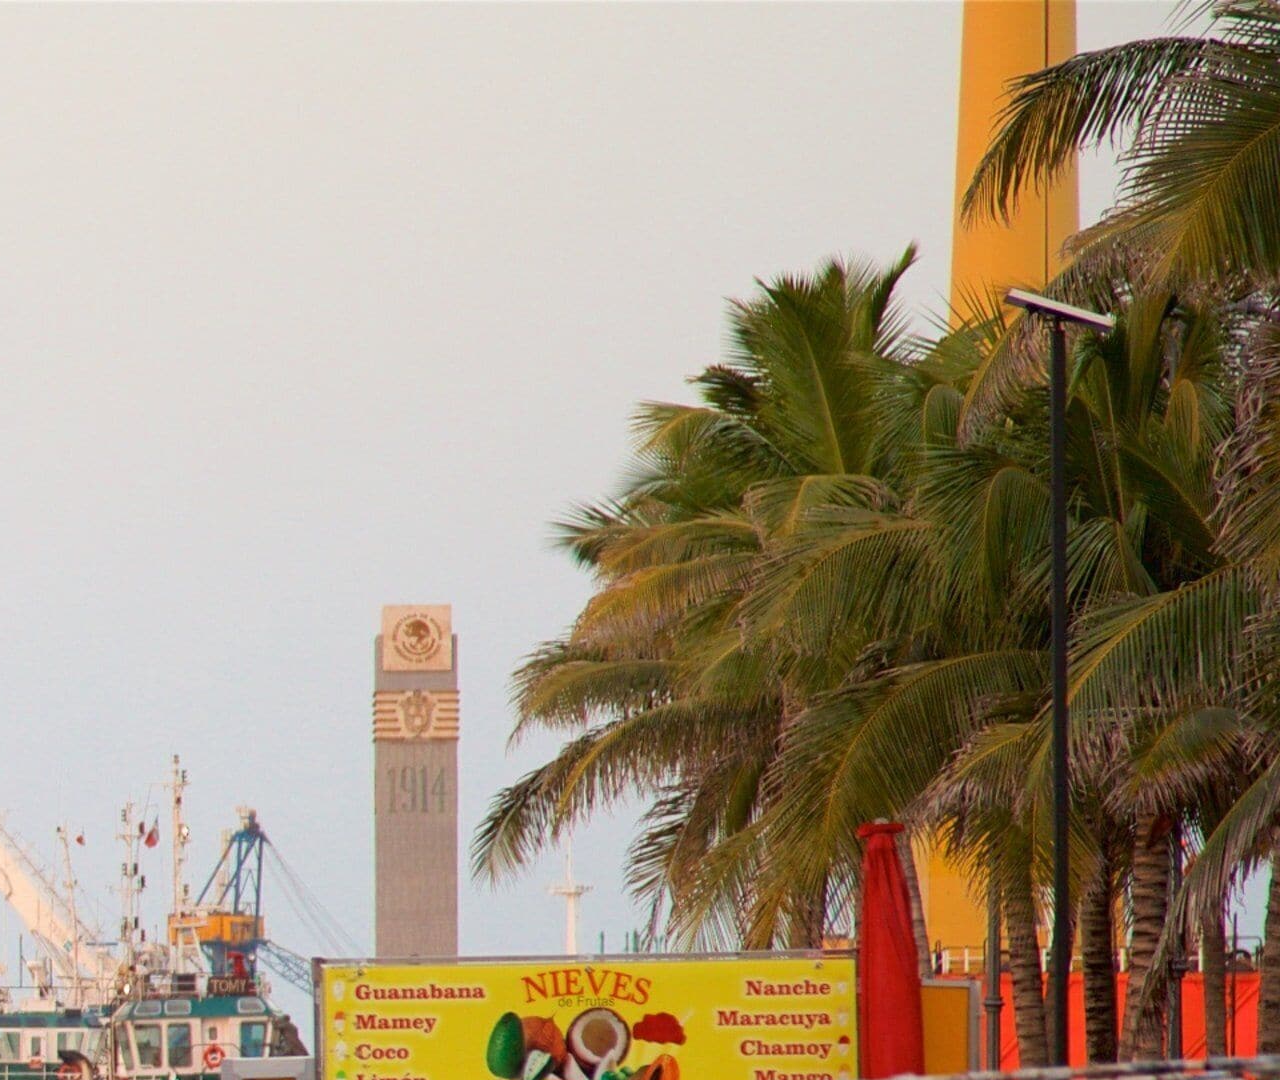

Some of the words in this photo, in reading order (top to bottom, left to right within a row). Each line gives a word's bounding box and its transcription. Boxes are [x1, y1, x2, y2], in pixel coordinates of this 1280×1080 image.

[387, 767, 446, 813] 1914
[210, 979, 247, 993] TOMY
[355, 984, 485, 1000] Guanabana
[521, 968, 652, 1005] NIEVES
[746, 980, 831, 996] Nanche
[558, 998, 572, 1007] de
[577, 996, 616, 1007] Frutas
[355, 1014, 436, 1033] Mamey
[717, 1011, 832, 1029] Maracuya
[355, 1044, 409, 1060] Coco
[740, 1040, 832, 1059] Chamoy
